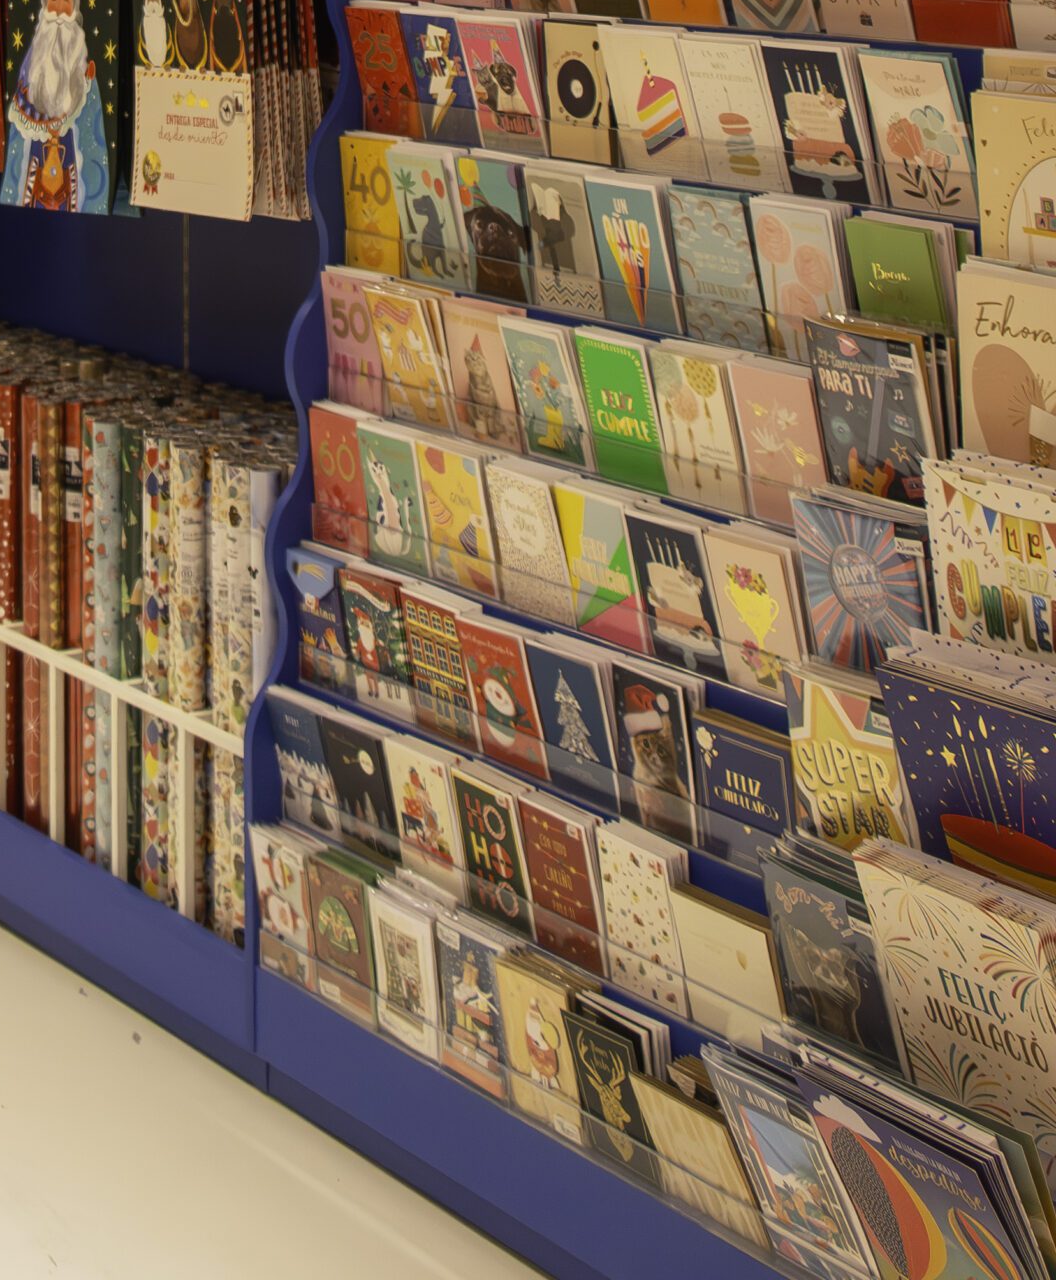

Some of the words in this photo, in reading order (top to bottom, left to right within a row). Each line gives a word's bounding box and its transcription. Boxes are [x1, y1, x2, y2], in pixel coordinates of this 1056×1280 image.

[359, 32, 397, 72] 25
[166, 114, 191, 127] ENTREGA
[192, 117, 220, 129] ESPECIAL
[350, 157, 391, 206] 40
[612, 197, 628, 215] UN
[331, 297, 370, 344] 50
[820, 367, 855, 396] PARA
[855, 375, 873, 400] TI
[597, 408, 652, 443] CUMPLE
[319, 441, 356, 482] 60
[946, 559, 1056, 654] CUMPLE
[726, 768, 761, 797] FELIZ
[796, 738, 896, 808] SUPER
[465, 793, 506, 840] HO
[817, 790, 892, 840] STAR
[471, 831, 514, 879] HO
[477, 869, 519, 918] HO
[938, 966, 1006, 1025] FELIÇ
